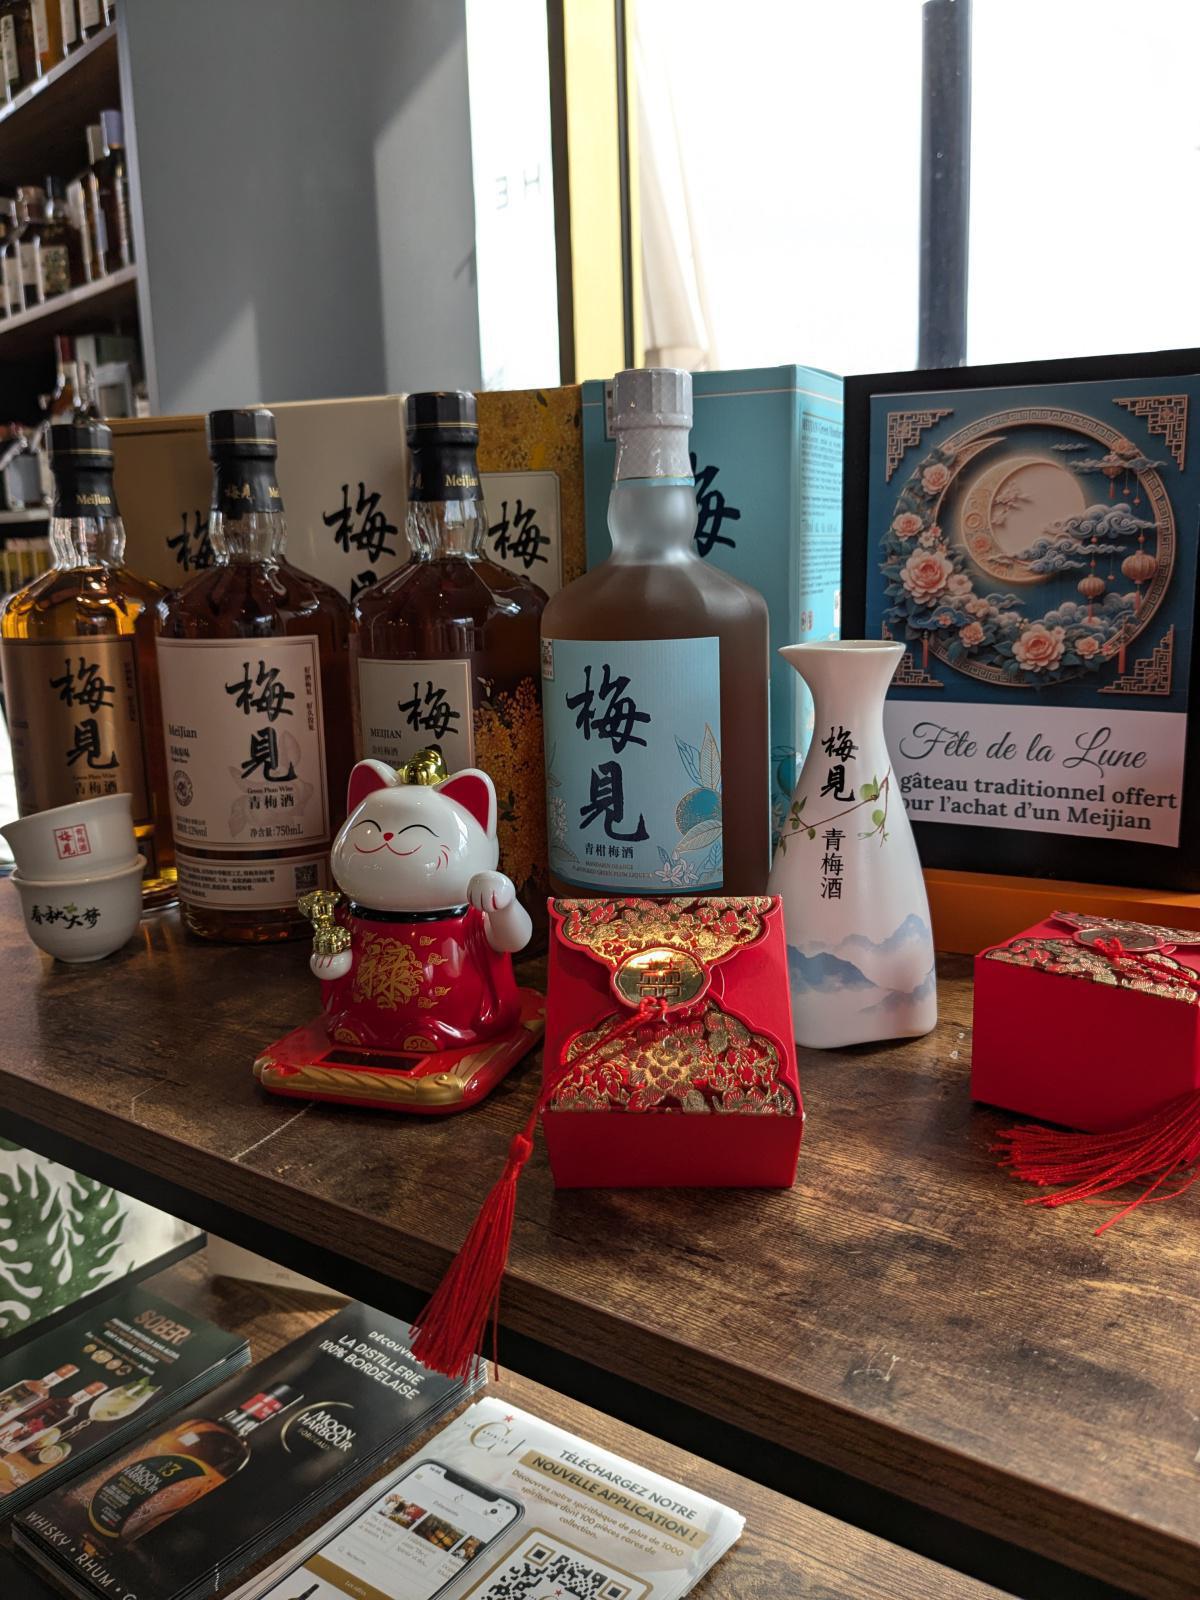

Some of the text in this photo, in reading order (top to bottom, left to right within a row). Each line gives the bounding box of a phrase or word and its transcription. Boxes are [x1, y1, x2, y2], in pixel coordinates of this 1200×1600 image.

[50, 656, 119, 769] 梅見
[225, 660, 297, 782] 梅見
[565, 663, 651, 841] 梅見
[820, 725, 859, 802] 梅見
[899, 722, 1148, 778] Fête de la Lune
[901, 773, 1178, 809] gâteau traditionnel offert
[940, 796, 1008, 817] l’achat
[1014, 801, 1060, 822] d’un
[1068, 806, 1152, 832] Meijian
[820, 827, 846, 900] 青梅酒
[319, 1340, 421, 1400] 100% BORDELAISE
[338, 1335, 426, 1386] LA DISTILLERIE
[297, 1412, 353, 1452] HARBOUR
[311, 1410, 357, 1441] MOON
[532, 1455, 699, 1542] NOUVELLE APPLICATION !
[559, 1449, 698, 1521] TÉLÉCHARGEZ NOTRE
[25, 1511, 72, 1546] WHISKY
[551, 1490, 573, 1502] notre
[618, 1522, 630, 1531] de
[629, 1528, 648, 1540] plus
[648, 1537, 660, 1546] de
[661, 1542, 684, 1557] 1000
[559, 1504, 580, 1517] dont
[580, 1514, 596, 1525] 100
[593, 1522, 620, 1538] pièces
[620, 1535, 645, 1550] rares
[644, 1545, 657, 1556] de
[75, 1552, 116, 1588] RHUM
